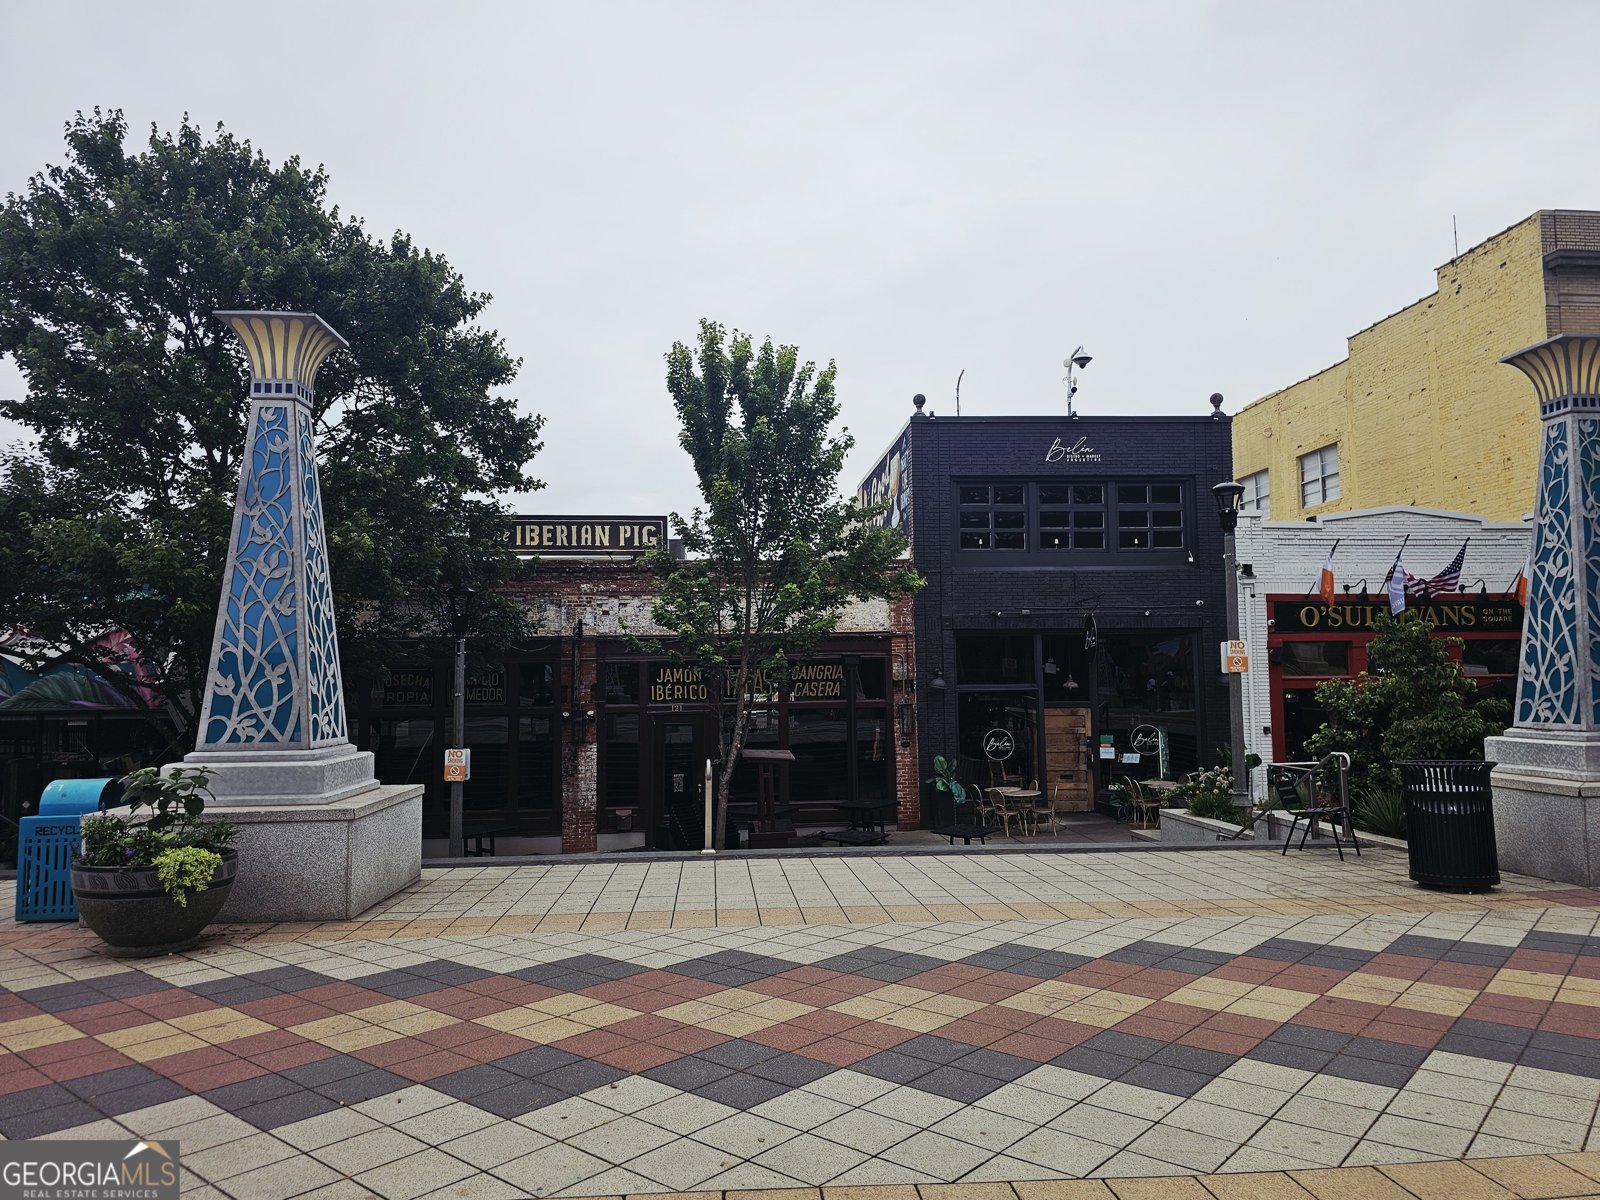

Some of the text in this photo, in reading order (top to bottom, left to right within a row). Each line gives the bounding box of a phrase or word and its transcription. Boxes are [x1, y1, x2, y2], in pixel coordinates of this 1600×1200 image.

[1045, 436, 1094, 463] Belin
[515, 525, 610, 546] IBERIAN
[619, 525, 657, 546] PIG
[1230, 641, 1245, 649] NO
[791, 665, 843, 681] SANGRIA
[651, 685, 707, 701] IBÉRICO
[794, 682, 840, 698] CASERA
[671, 704, 682, 712] 121
